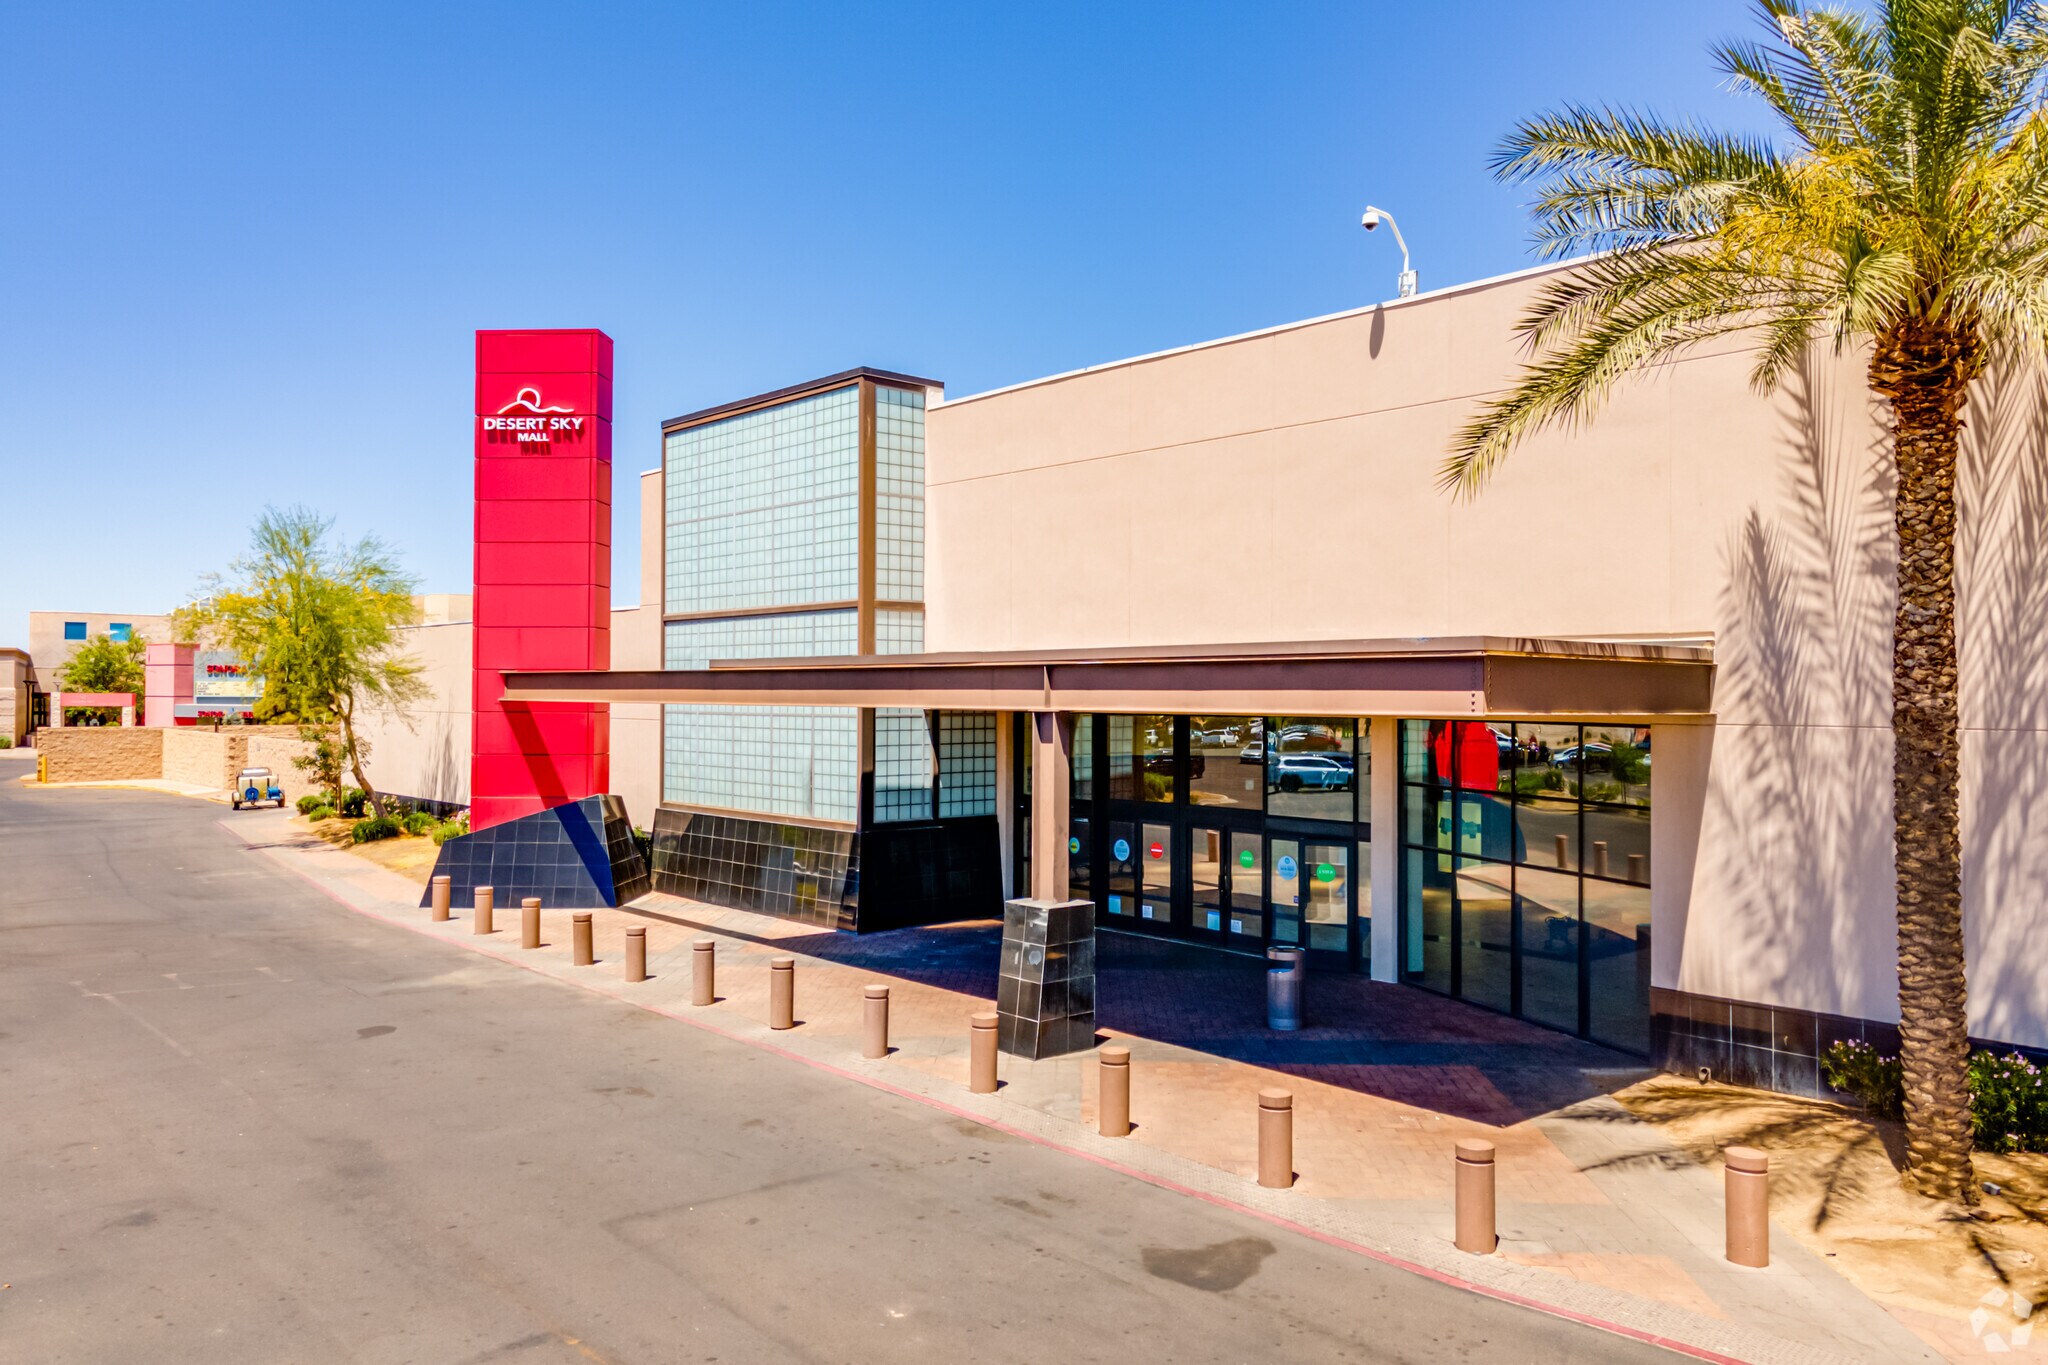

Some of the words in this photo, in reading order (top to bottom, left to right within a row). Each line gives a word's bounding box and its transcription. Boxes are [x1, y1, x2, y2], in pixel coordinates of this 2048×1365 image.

[483, 418, 547, 430] DESERT
[550, 418, 584, 430] SKY
[517, 432, 549, 442] MALL
